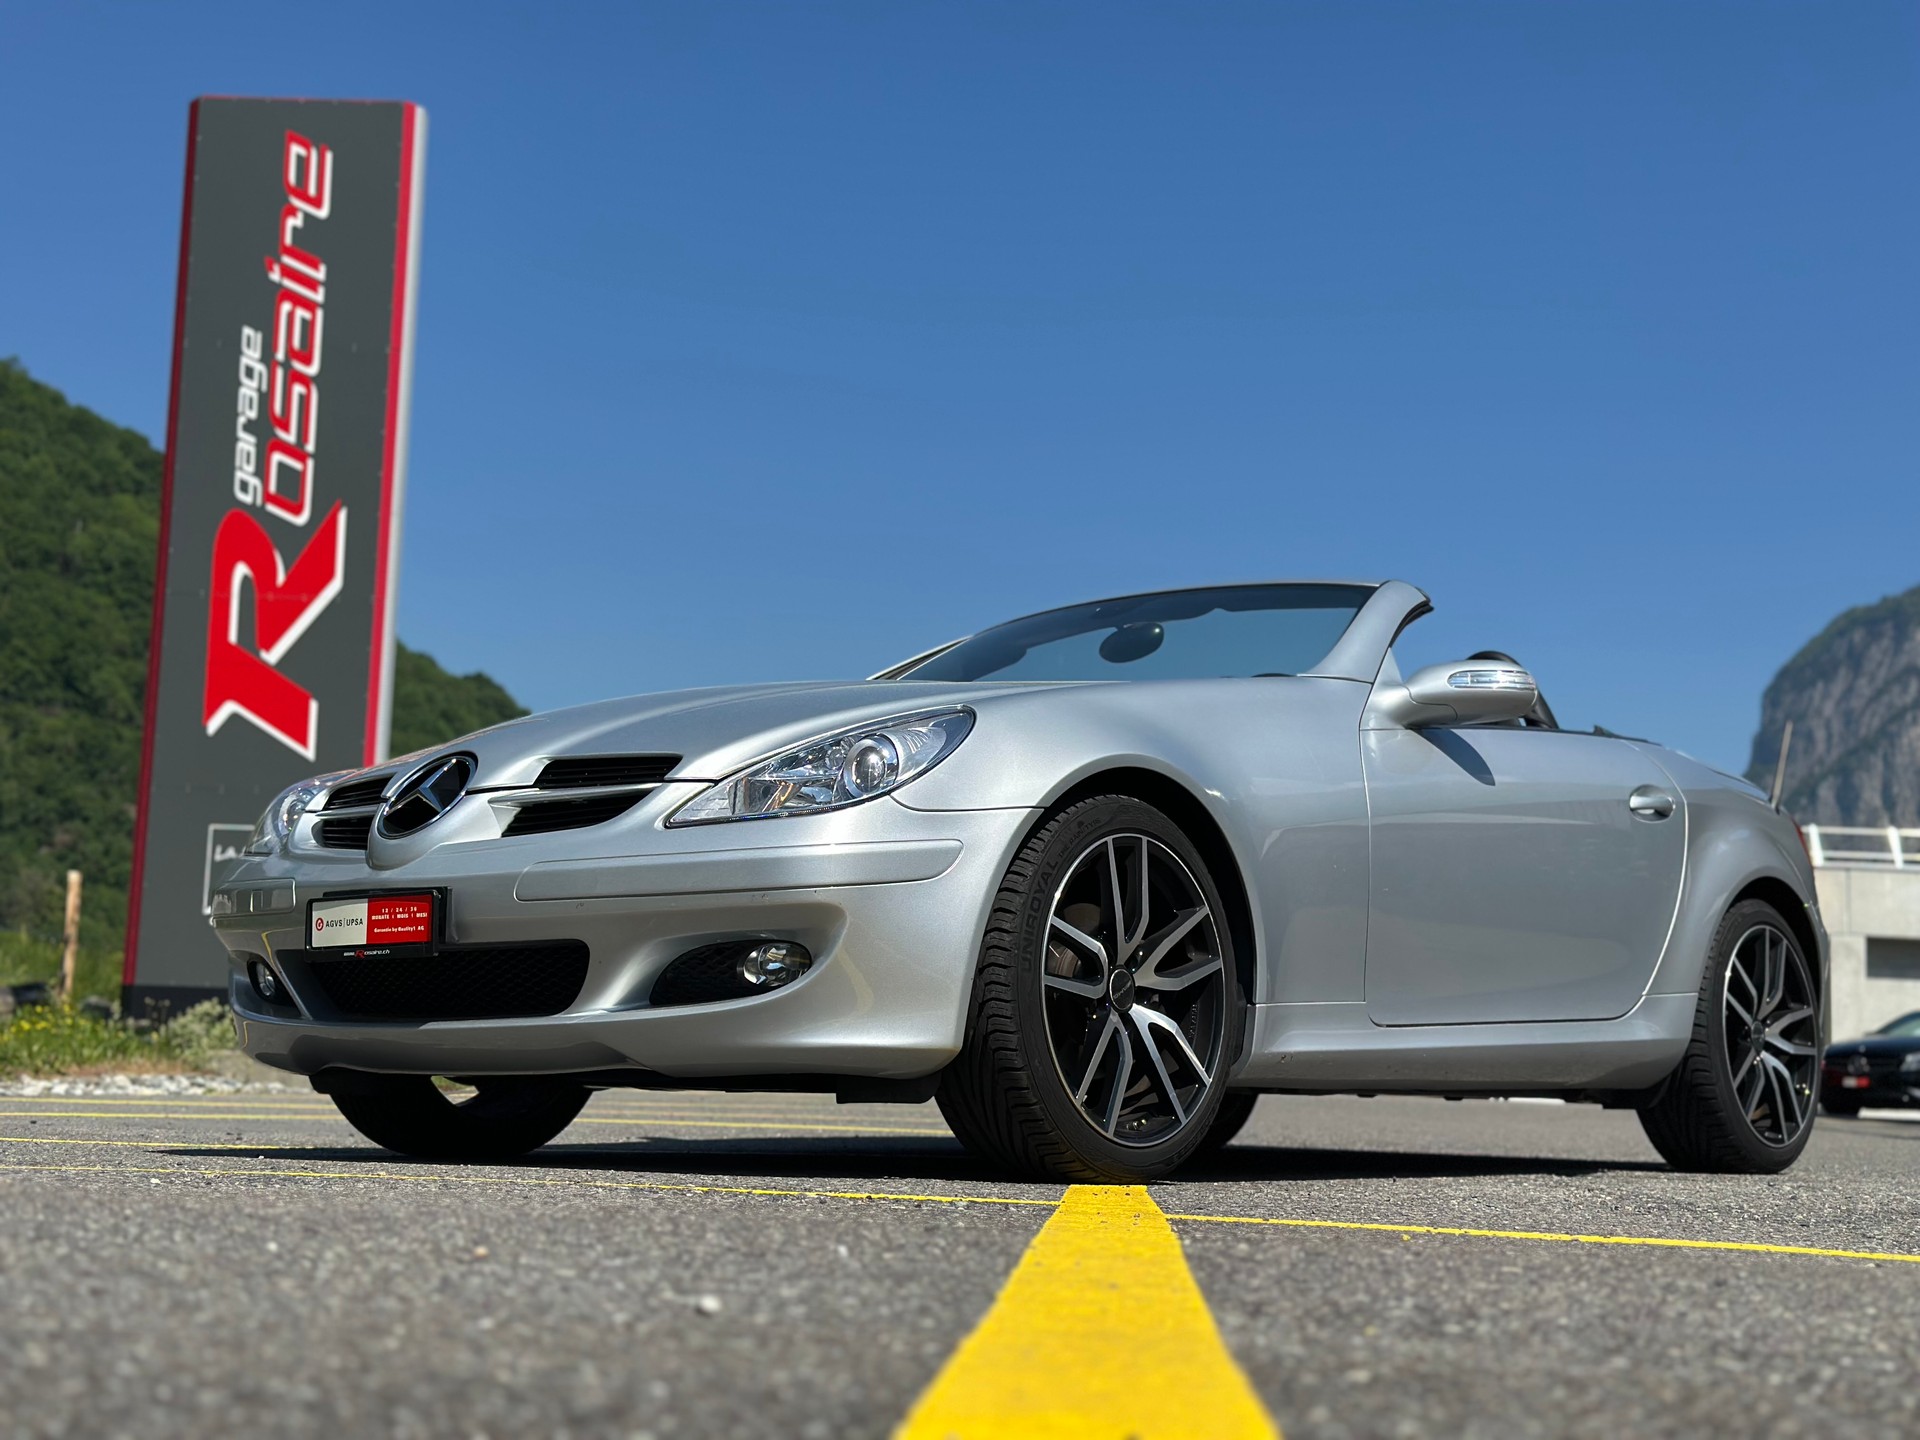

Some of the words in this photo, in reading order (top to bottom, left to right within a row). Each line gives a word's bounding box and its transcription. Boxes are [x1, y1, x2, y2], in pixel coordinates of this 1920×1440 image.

[202, 130, 347, 763] Rosaire
[234, 325, 268, 507] garage
[1021, 860, 1059, 972] UNIROYAL
